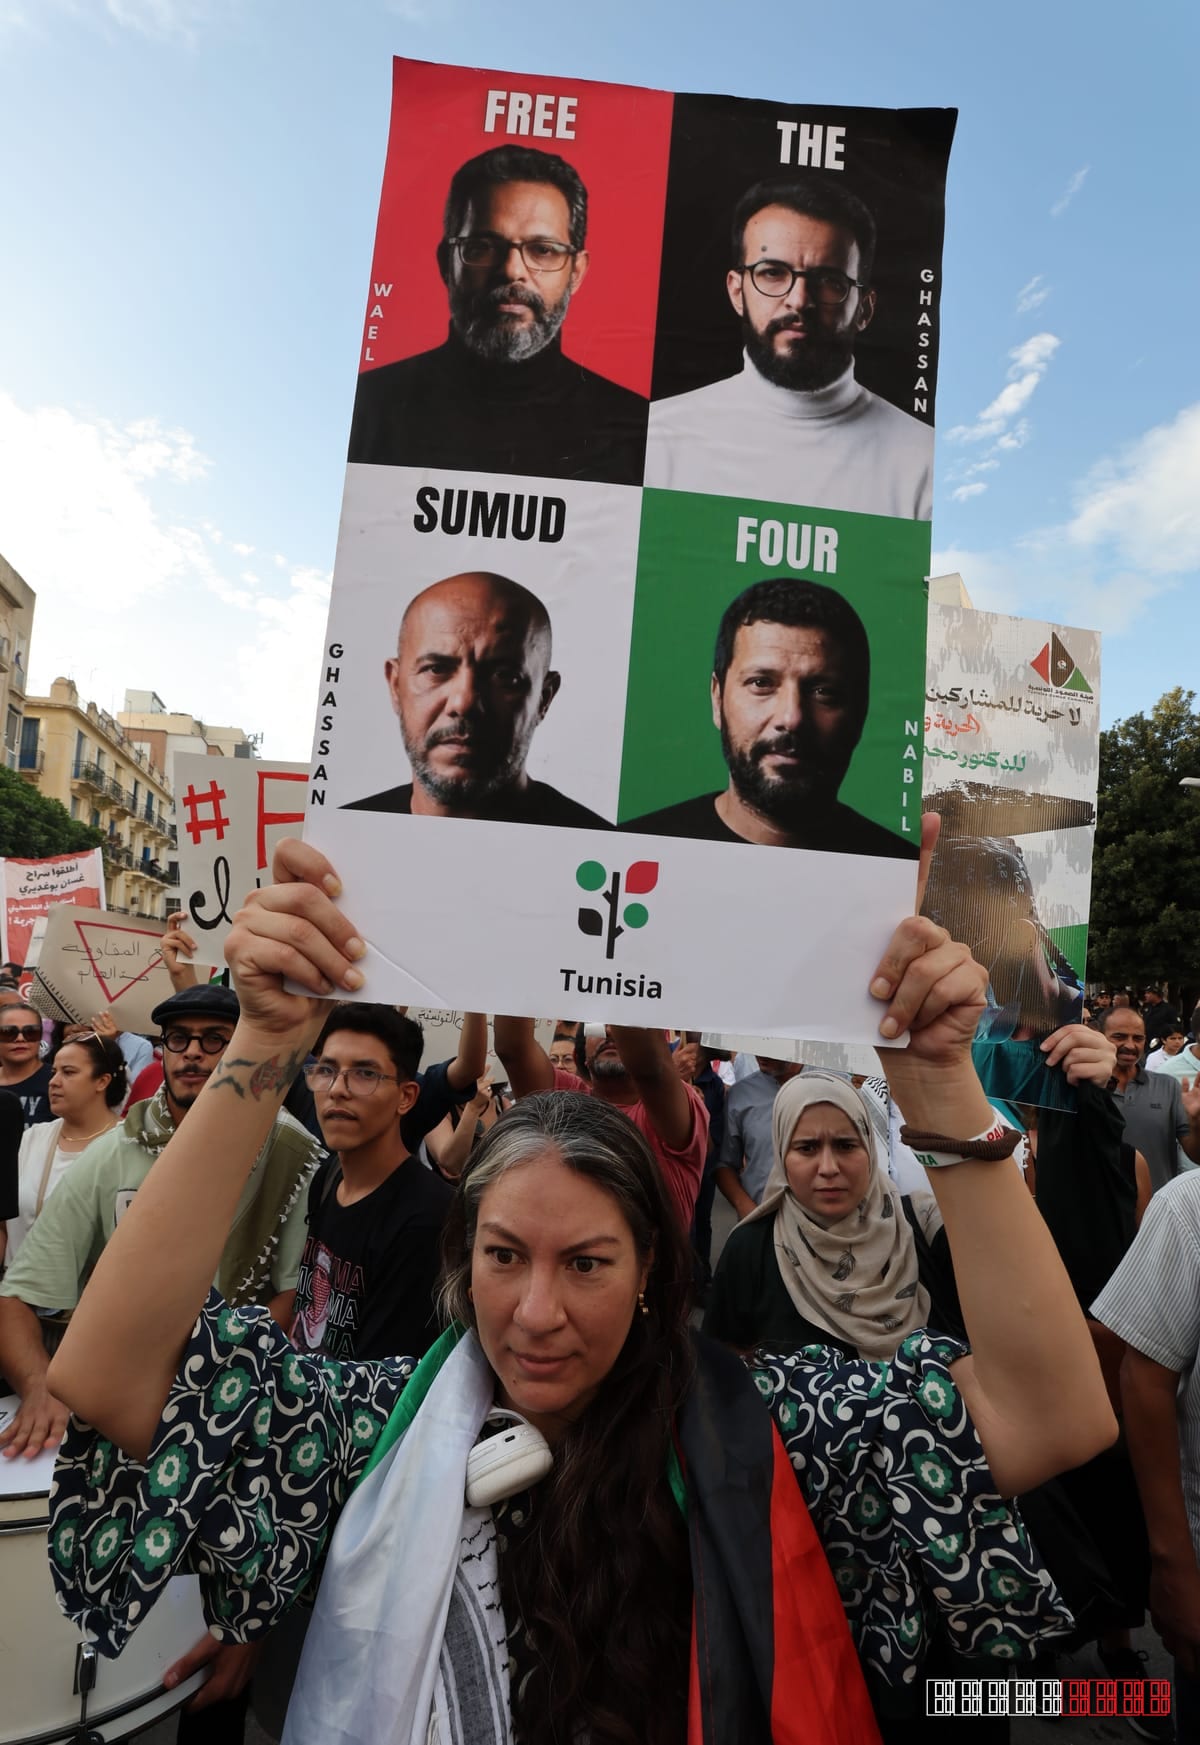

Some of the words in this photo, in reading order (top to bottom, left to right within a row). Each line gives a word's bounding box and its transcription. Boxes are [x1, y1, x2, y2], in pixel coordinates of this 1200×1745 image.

[484, 90, 578, 140] FREE
[776, 120, 847, 171] THE
[364, 282, 394, 363] WAEL
[914, 268, 935, 413] GHASSAN
[413, 486, 567, 544] SUMUD
[735, 516, 840, 574] FOUR
[311, 643, 344, 806] GHASSAN
[925, 687, 1023, 713] للمشاركين
[1024, 700, 1065, 723] حرية
[1068, 706, 1081, 726] لا
[902, 719, 919, 833] NABIL
[958, 751, 1027, 772] للدكتور
[559, 968, 662, 1000] Tunisia
